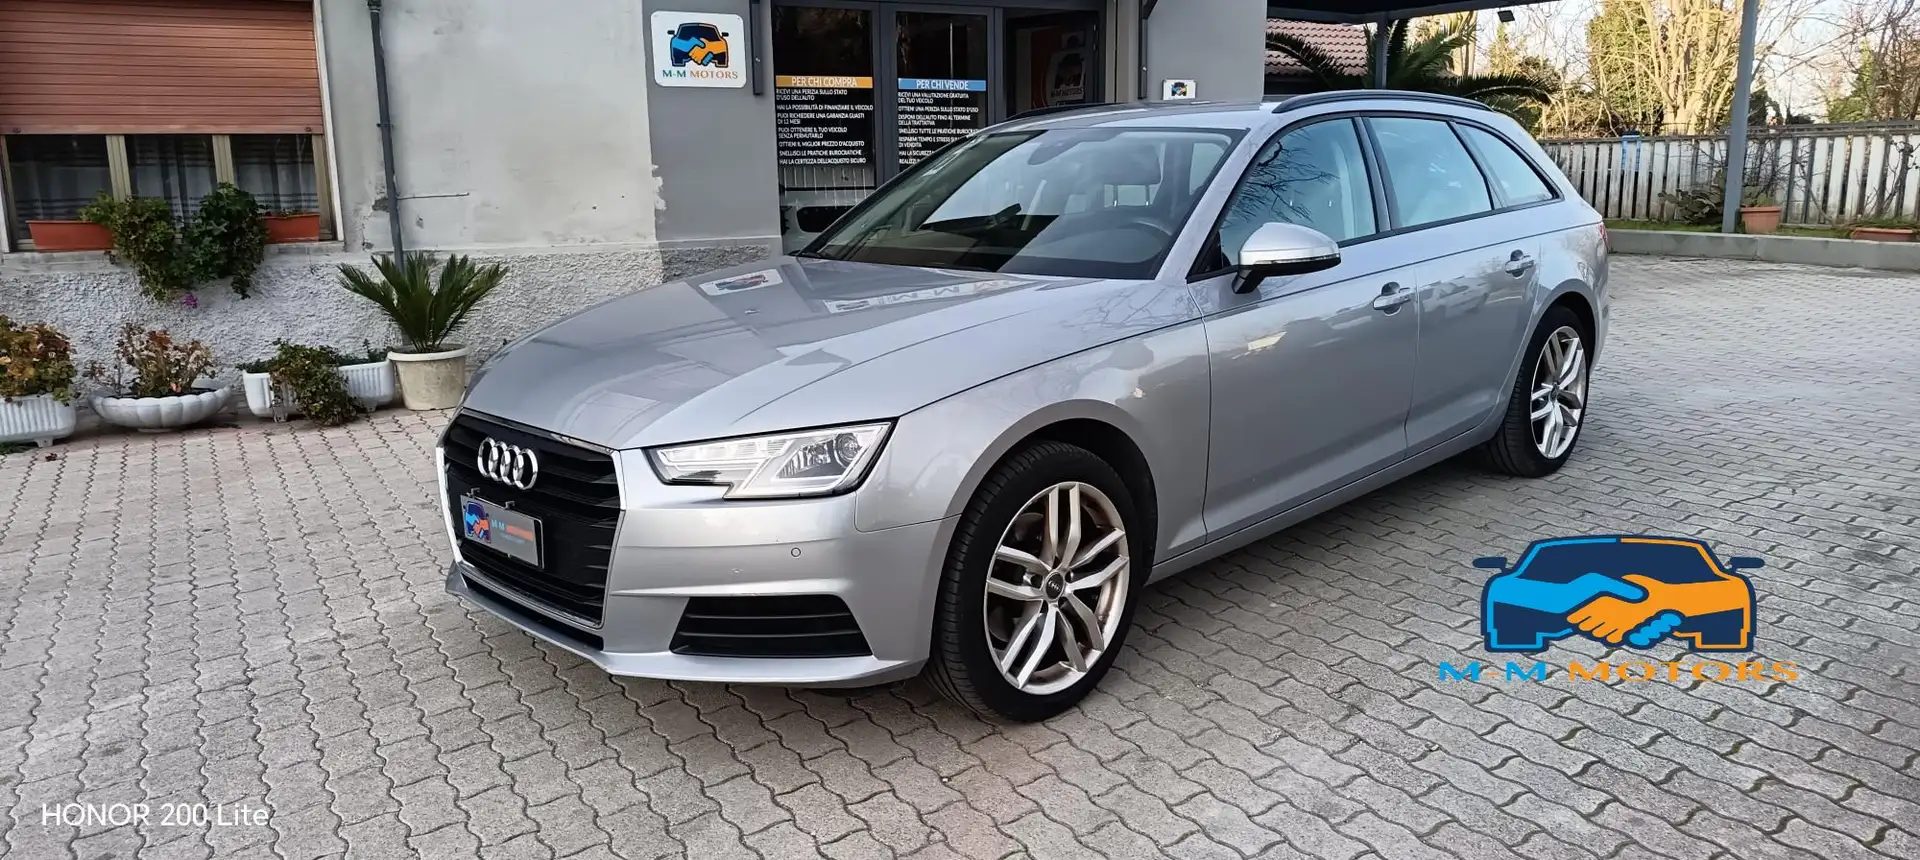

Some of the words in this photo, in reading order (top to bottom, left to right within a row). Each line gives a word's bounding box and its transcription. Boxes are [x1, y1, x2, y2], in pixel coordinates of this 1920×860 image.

[662, 70, 686, 78] M-M
[690, 70, 738, 78] MOTORS
[792, 77, 806, 86] PER
[808, 77, 822, 87] CHI
[823, 77, 857, 87] COMPRA
[916, 80, 930, 89] PER
[930, 80, 943, 89] CHI
[944, 80, 968, 90] VENDE
